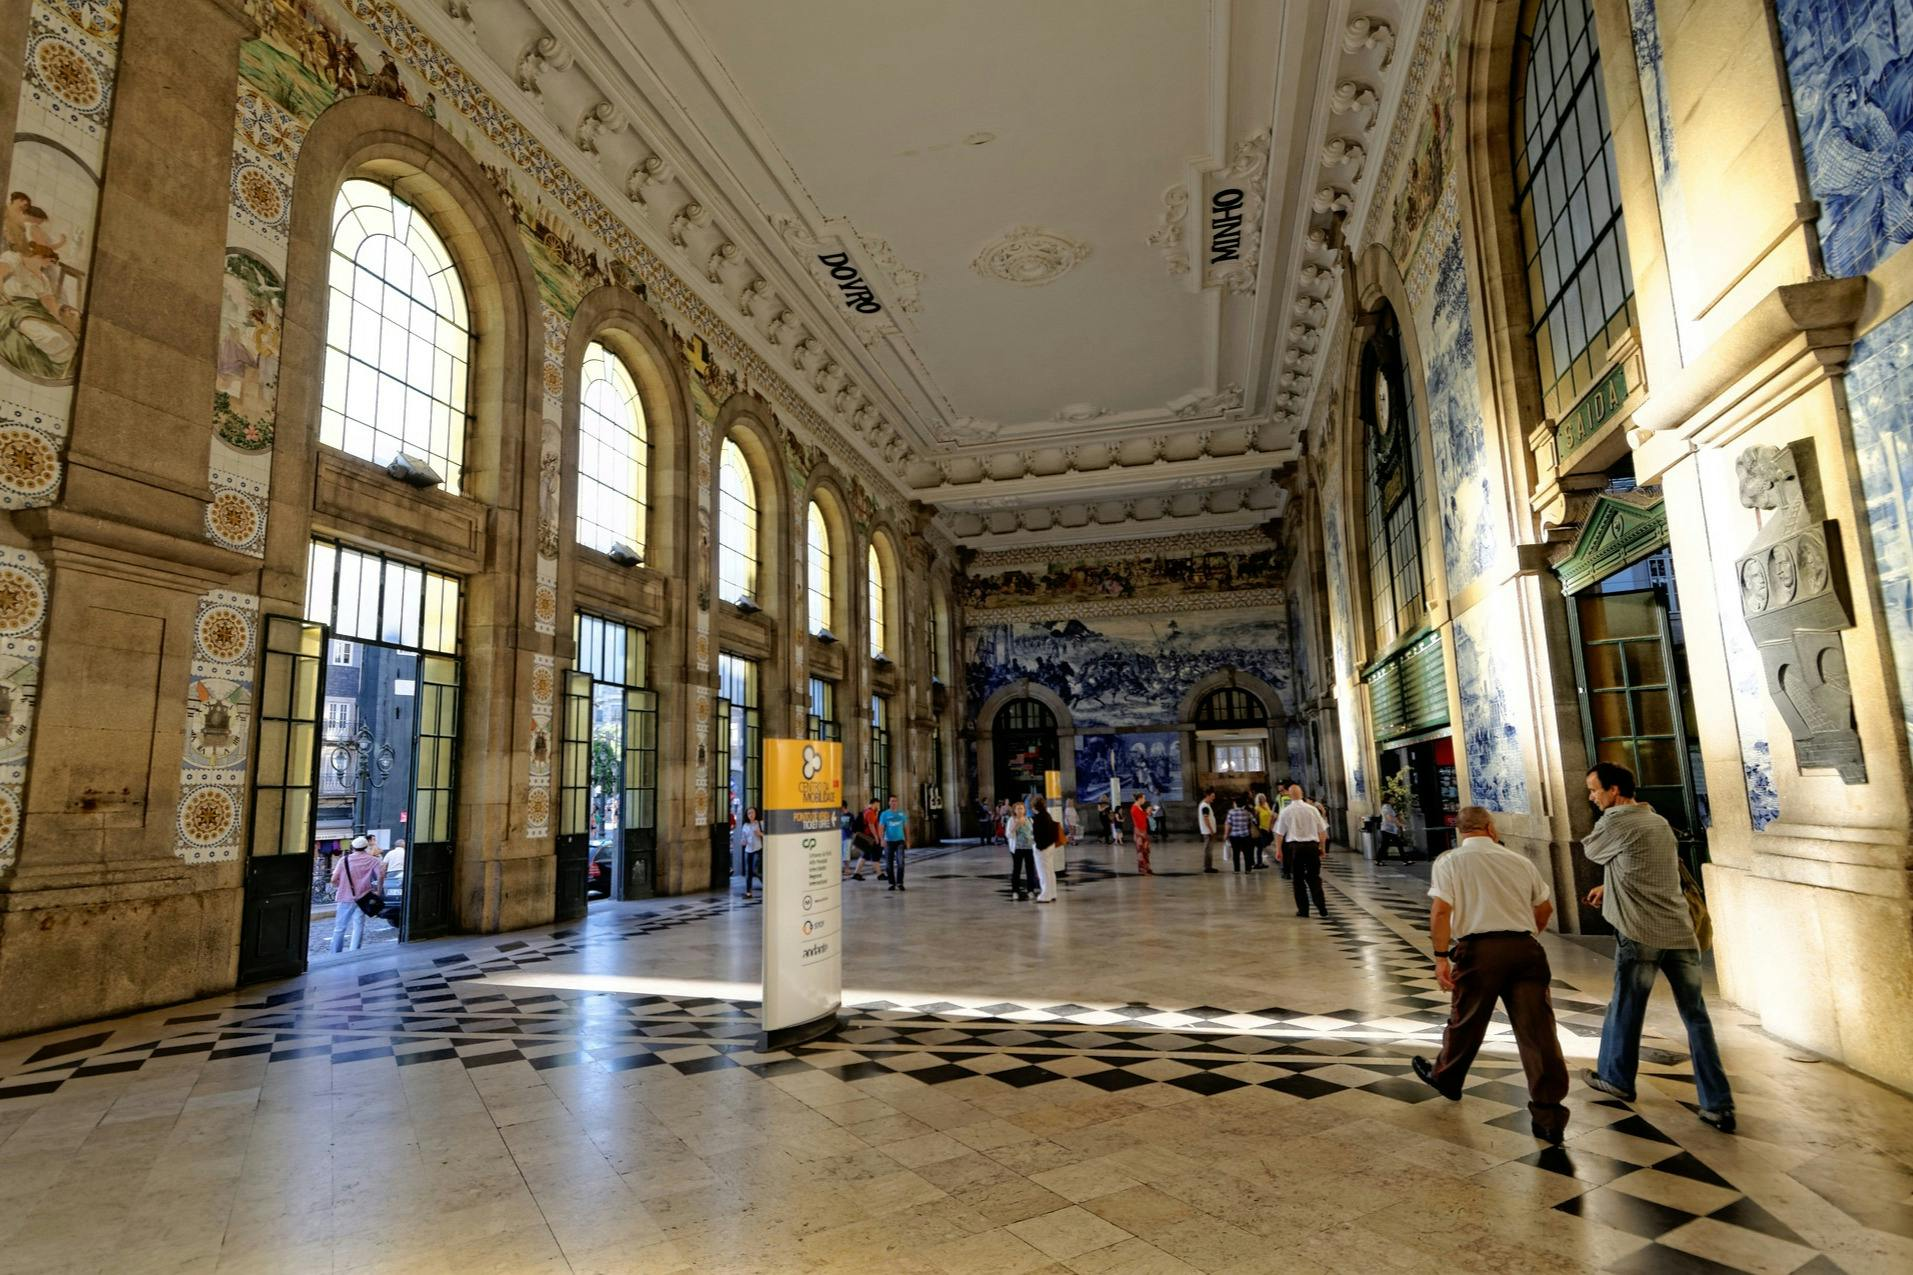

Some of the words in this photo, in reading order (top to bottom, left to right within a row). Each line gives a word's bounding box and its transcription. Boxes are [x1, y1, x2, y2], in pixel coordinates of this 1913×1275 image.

[1211, 188, 1244, 264] MINHO
[817, 252, 881, 314] DOVRO
[1564, 380, 1618, 449] SAIDA
